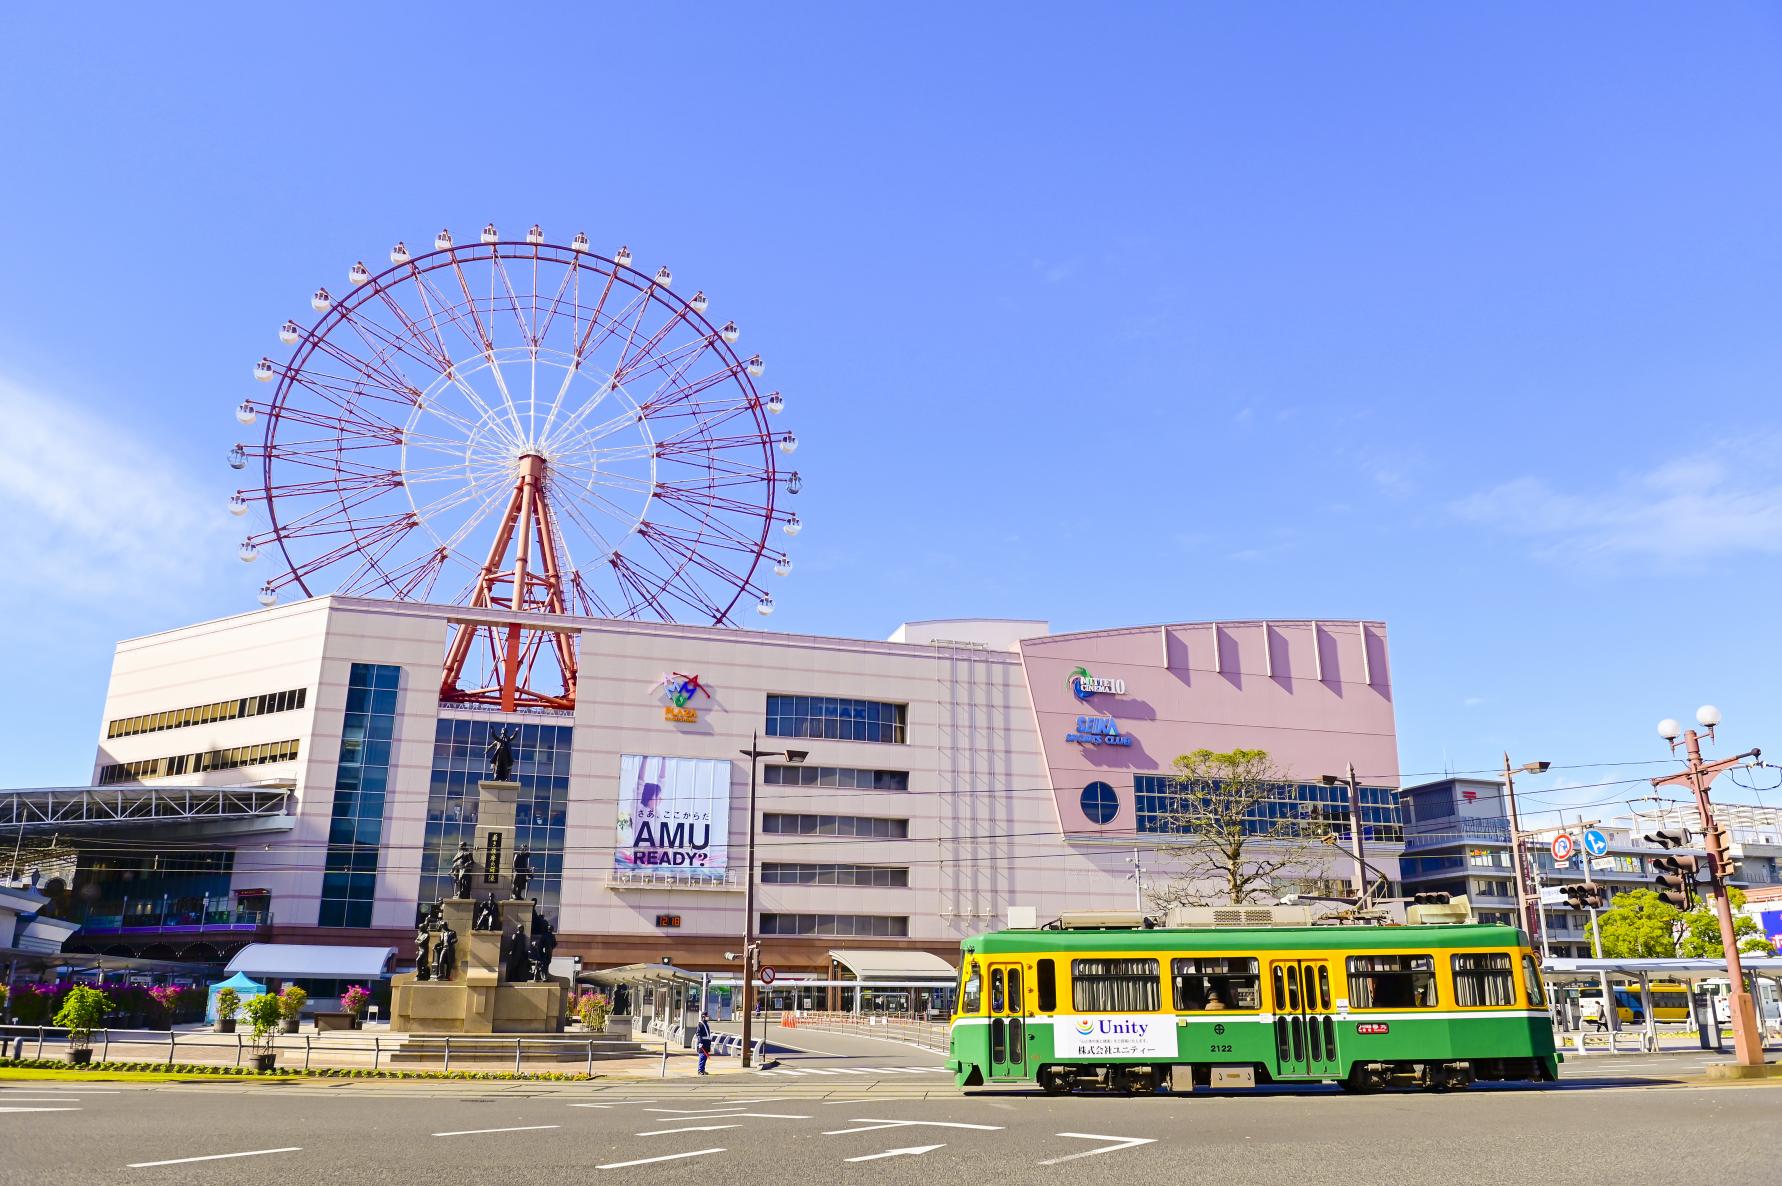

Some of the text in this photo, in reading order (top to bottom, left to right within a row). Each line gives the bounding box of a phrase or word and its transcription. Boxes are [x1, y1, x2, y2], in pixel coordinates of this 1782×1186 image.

[1081, 685, 1110, 693] CINEMA
[1110, 679, 1125, 695] 10
[633, 820, 710, 850] AMU
[633, 851, 708, 867] READY?
[1098, 1019, 1148, 1037] Unity
[1078, 1045, 1156, 1055] 株式会社ユニティー
[1210, 1045, 1232, 1053] 2122
